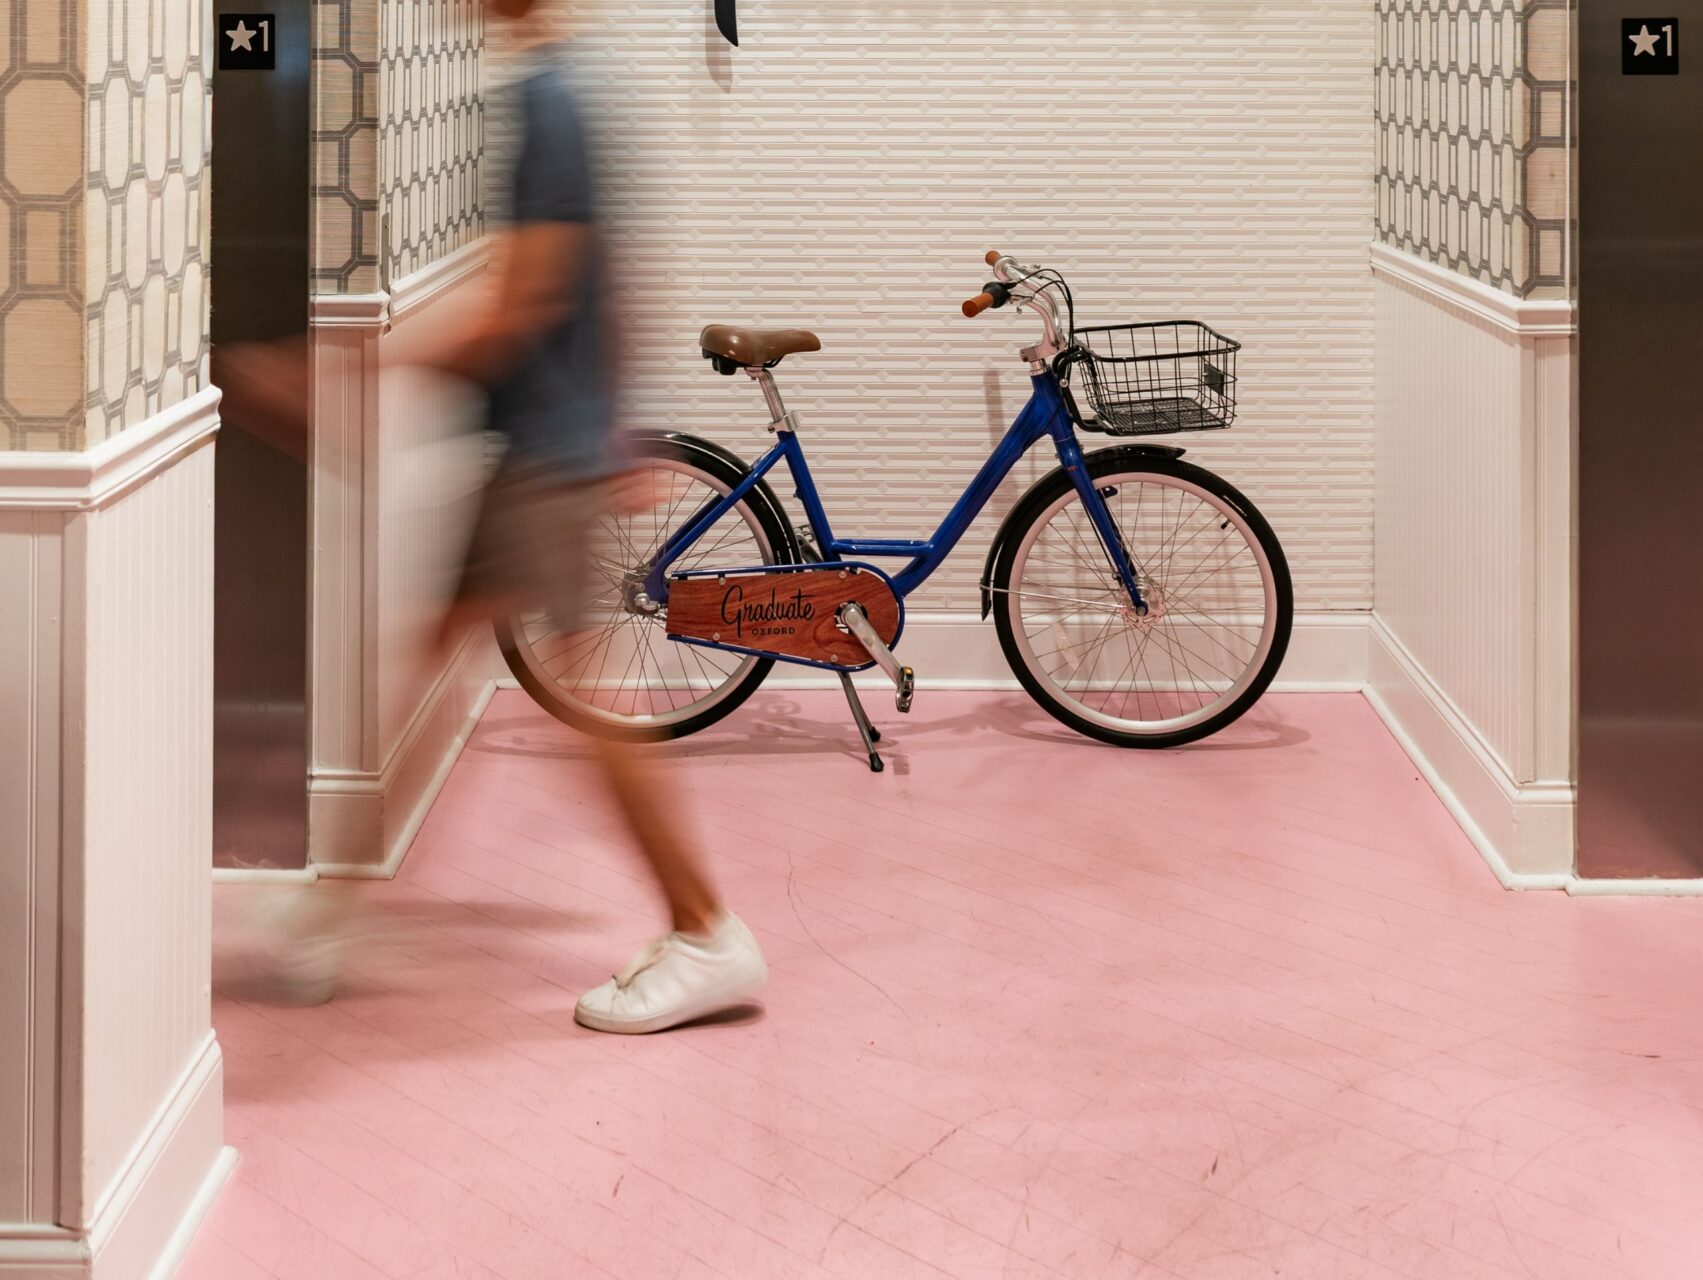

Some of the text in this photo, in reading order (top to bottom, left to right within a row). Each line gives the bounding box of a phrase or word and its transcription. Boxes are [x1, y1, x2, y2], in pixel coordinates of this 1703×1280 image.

[258, 20, 269, 52] 1
[1662, 25, 1673, 57] 1
[721, 585, 816, 639] Graduate
[751, 626, 796, 636] OXFORD
